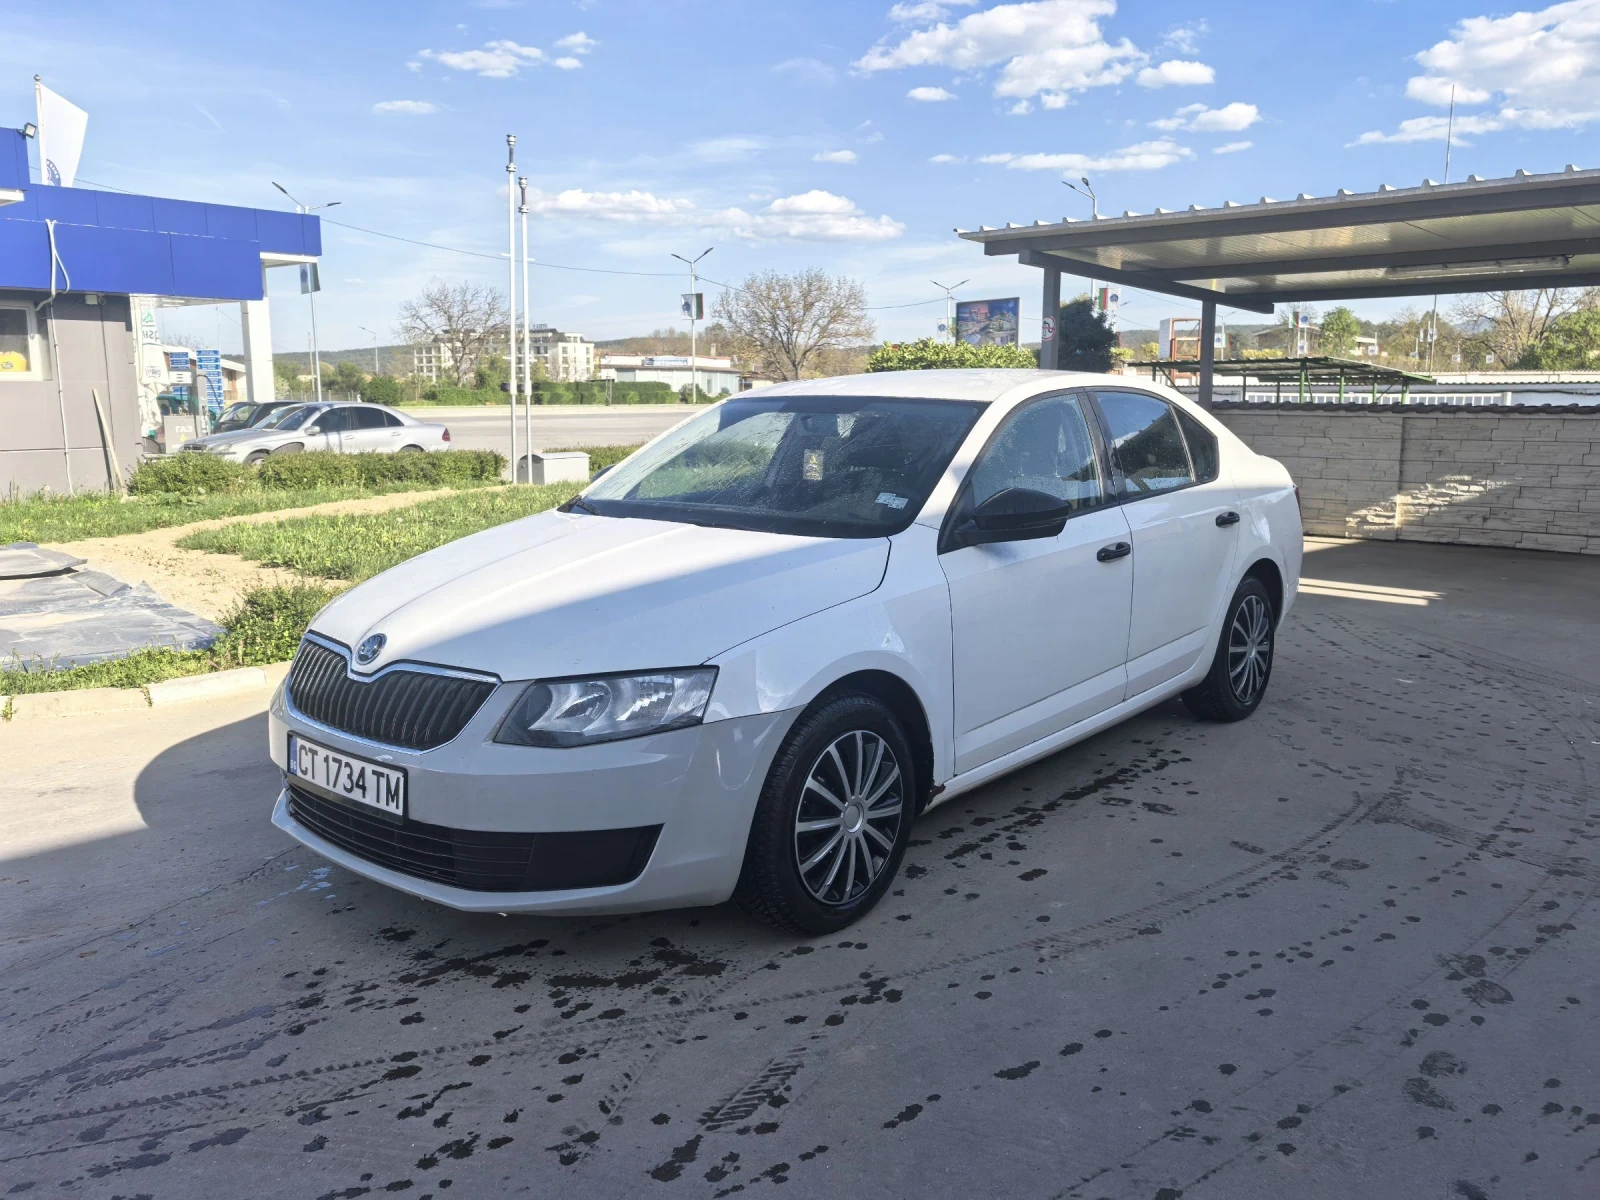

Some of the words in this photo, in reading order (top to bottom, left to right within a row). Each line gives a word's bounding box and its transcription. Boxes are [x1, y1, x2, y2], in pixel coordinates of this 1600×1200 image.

[299, 744, 318, 780] CT
[323, 754, 367, 799] 1734
[372, 769, 401, 810] TM
